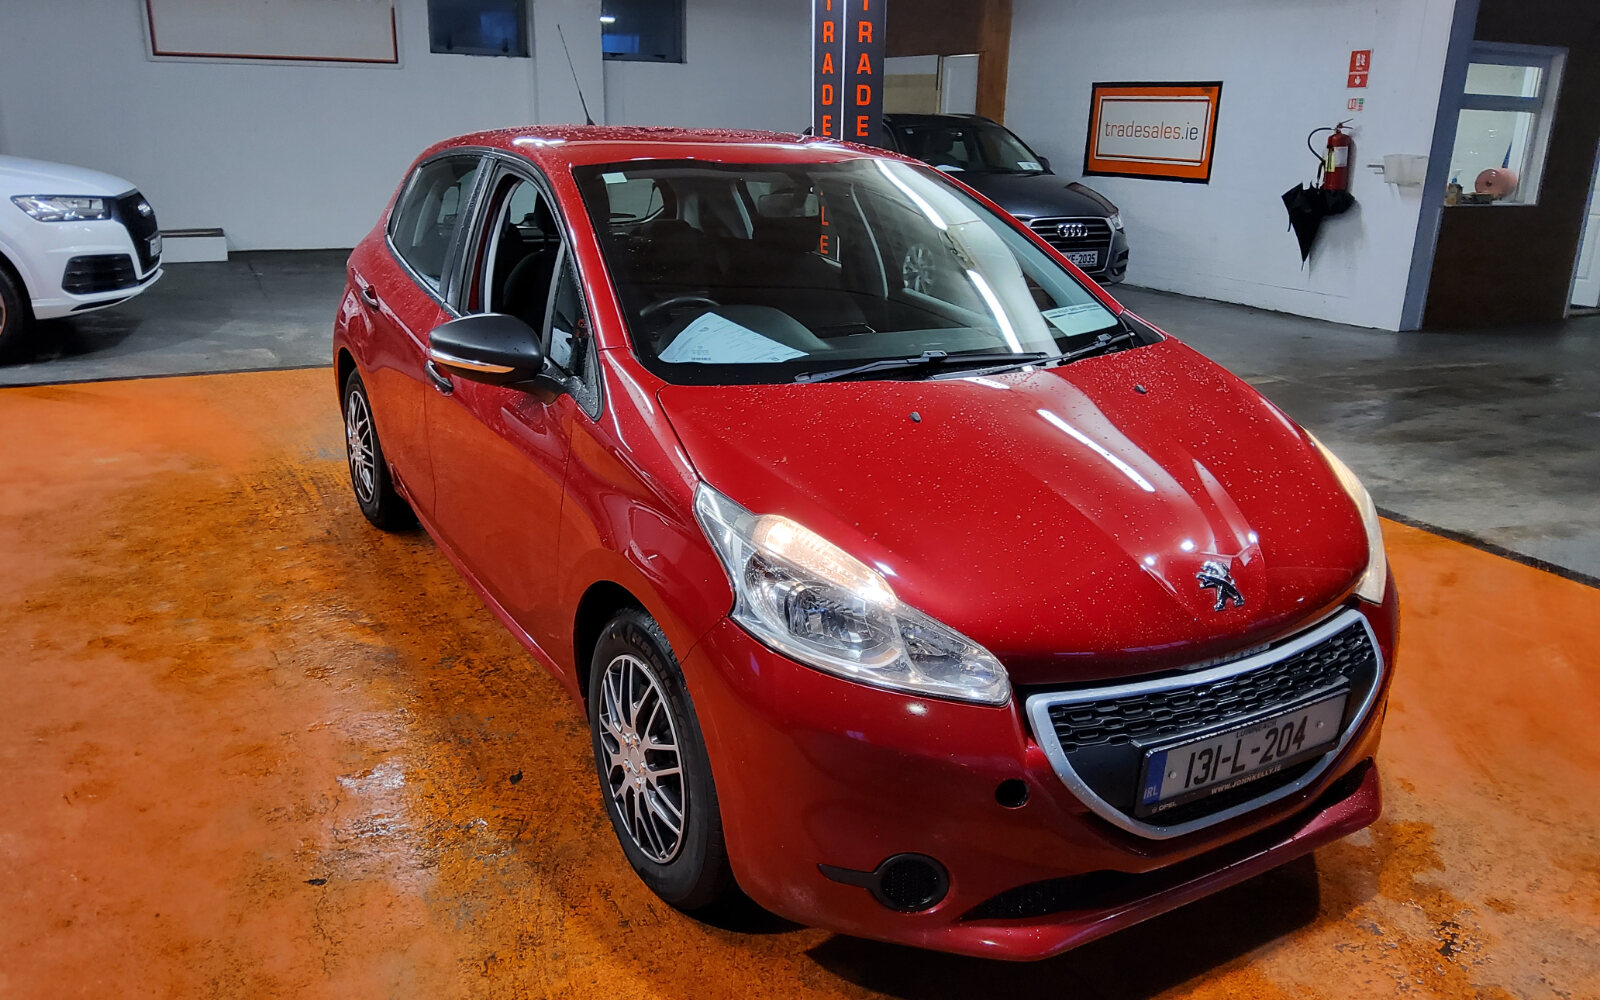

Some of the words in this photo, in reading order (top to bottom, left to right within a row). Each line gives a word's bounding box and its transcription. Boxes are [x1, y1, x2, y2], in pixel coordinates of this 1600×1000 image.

[1105, 120, 1199, 141] tradesales.ie
[1143, 785, 1159, 799] IRL
[1184, 715, 1308, 789] 131-L-204
